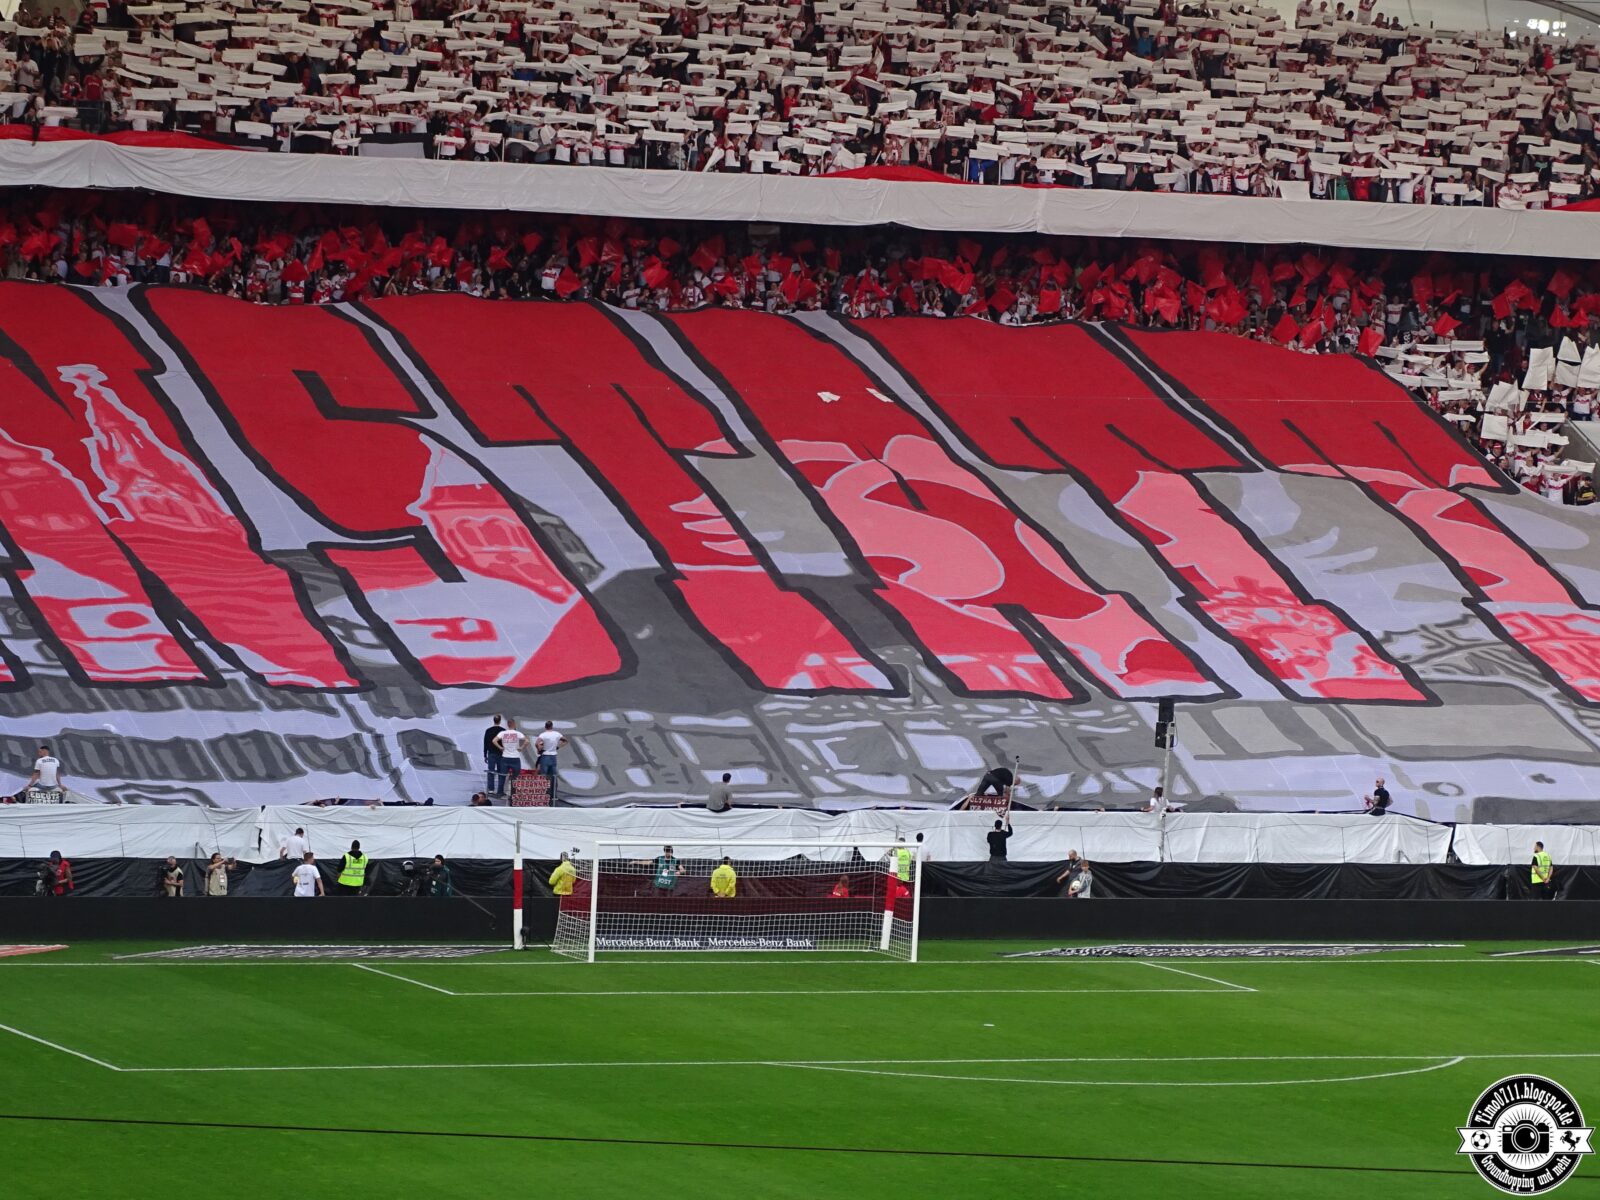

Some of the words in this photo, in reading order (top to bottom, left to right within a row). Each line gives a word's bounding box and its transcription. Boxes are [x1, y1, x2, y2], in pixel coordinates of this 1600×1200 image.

[596, 937, 672, 947] Mercedes-Benz
[673, 938, 701, 947] Bank
[708, 937, 784, 947] Mercedes-Benz
[785, 938, 813, 947] Bank
